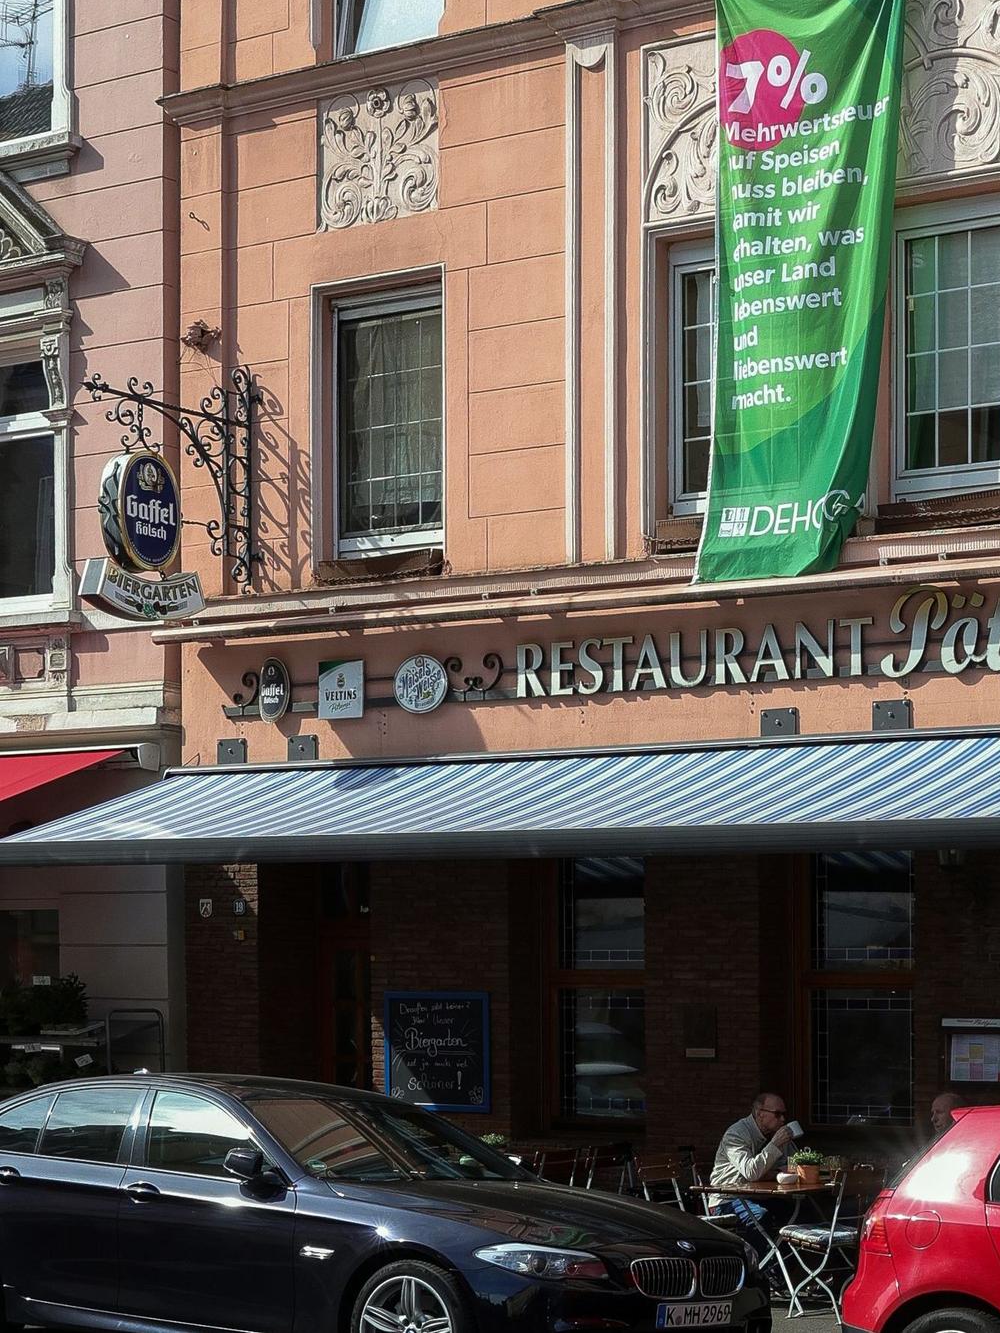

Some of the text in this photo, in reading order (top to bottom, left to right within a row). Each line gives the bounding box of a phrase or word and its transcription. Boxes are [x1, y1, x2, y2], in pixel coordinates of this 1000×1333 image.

[726, 49, 828, 114] 7%
[761, 139, 840, 174] Speisen
[782, 166, 869, 197] bleiben,
[788, 201, 821, 224] wir
[819, 226, 865, 247] was
[781, 256, 836, 283] Land
[731, 384, 792, 410] macht.
[126, 494, 176, 526] Gaffel
[135, 521, 167, 541] Kölsch
[107, 566, 199, 602] BIERGARTEN
[515, 616, 873, 698] RESTAURANT
[325, 689, 358, 702] VELTINS
[404, 1026, 469, 1057] Biergarten
[666, 1305, 732, 1326] K MH 2969
